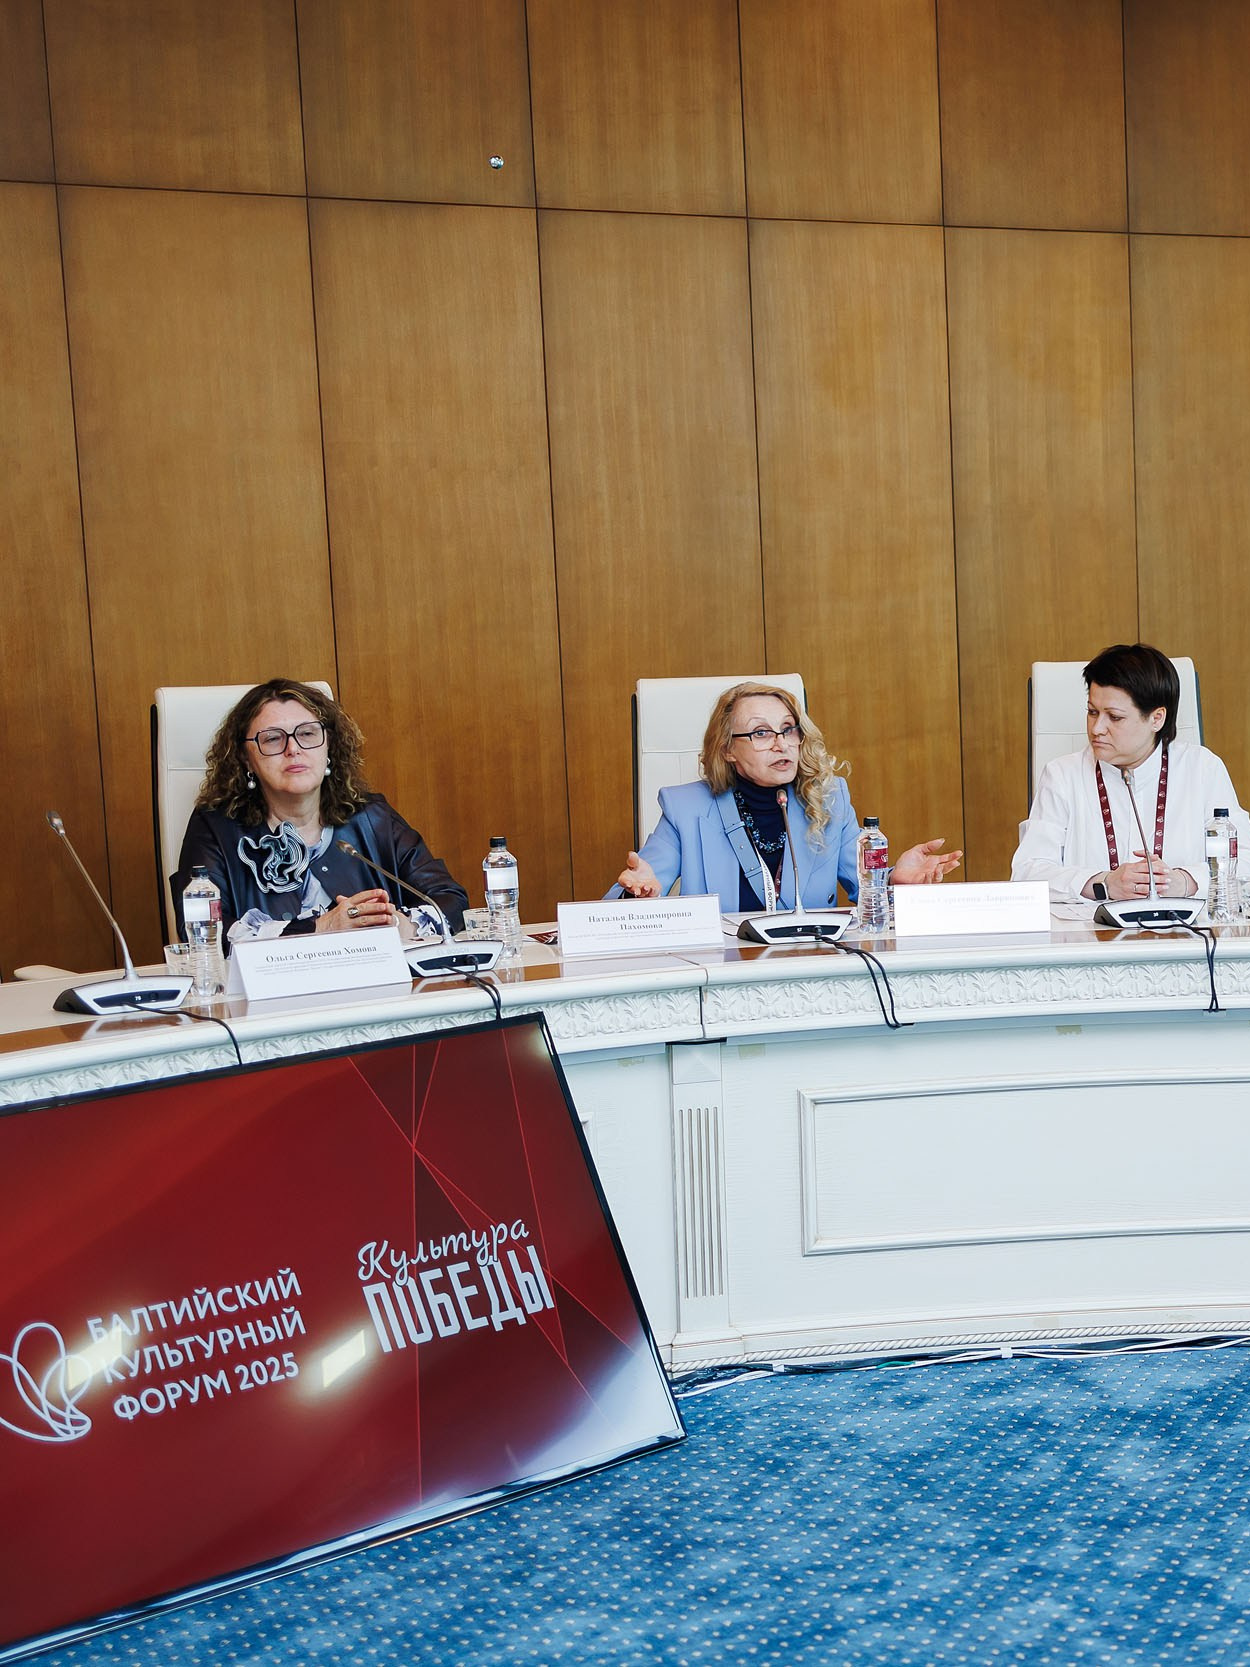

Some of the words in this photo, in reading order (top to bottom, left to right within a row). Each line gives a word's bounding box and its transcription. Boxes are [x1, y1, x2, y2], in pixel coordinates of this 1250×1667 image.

[588, 914, 626, 923] Наталья
[628, 910, 692, 921] Владимировна
[620, 922, 663, 931] Пахомова
[265, 953, 295, 963] Ольга
[296, 949, 342, 961] Сергеевна
[343, 945, 378, 955] Хомова
[356, 1218, 531, 1287] Культура
[86, 1267, 302, 1343] БАЛТИЙСКИЙ
[361, 1244, 557, 1354] ПОБЕДЫ
[103, 1305, 307, 1384] КУЛЬТУРНЫЙ
[113, 1369, 232, 1421] ФОРУМ
[234, 1352, 300, 1391] 2025
